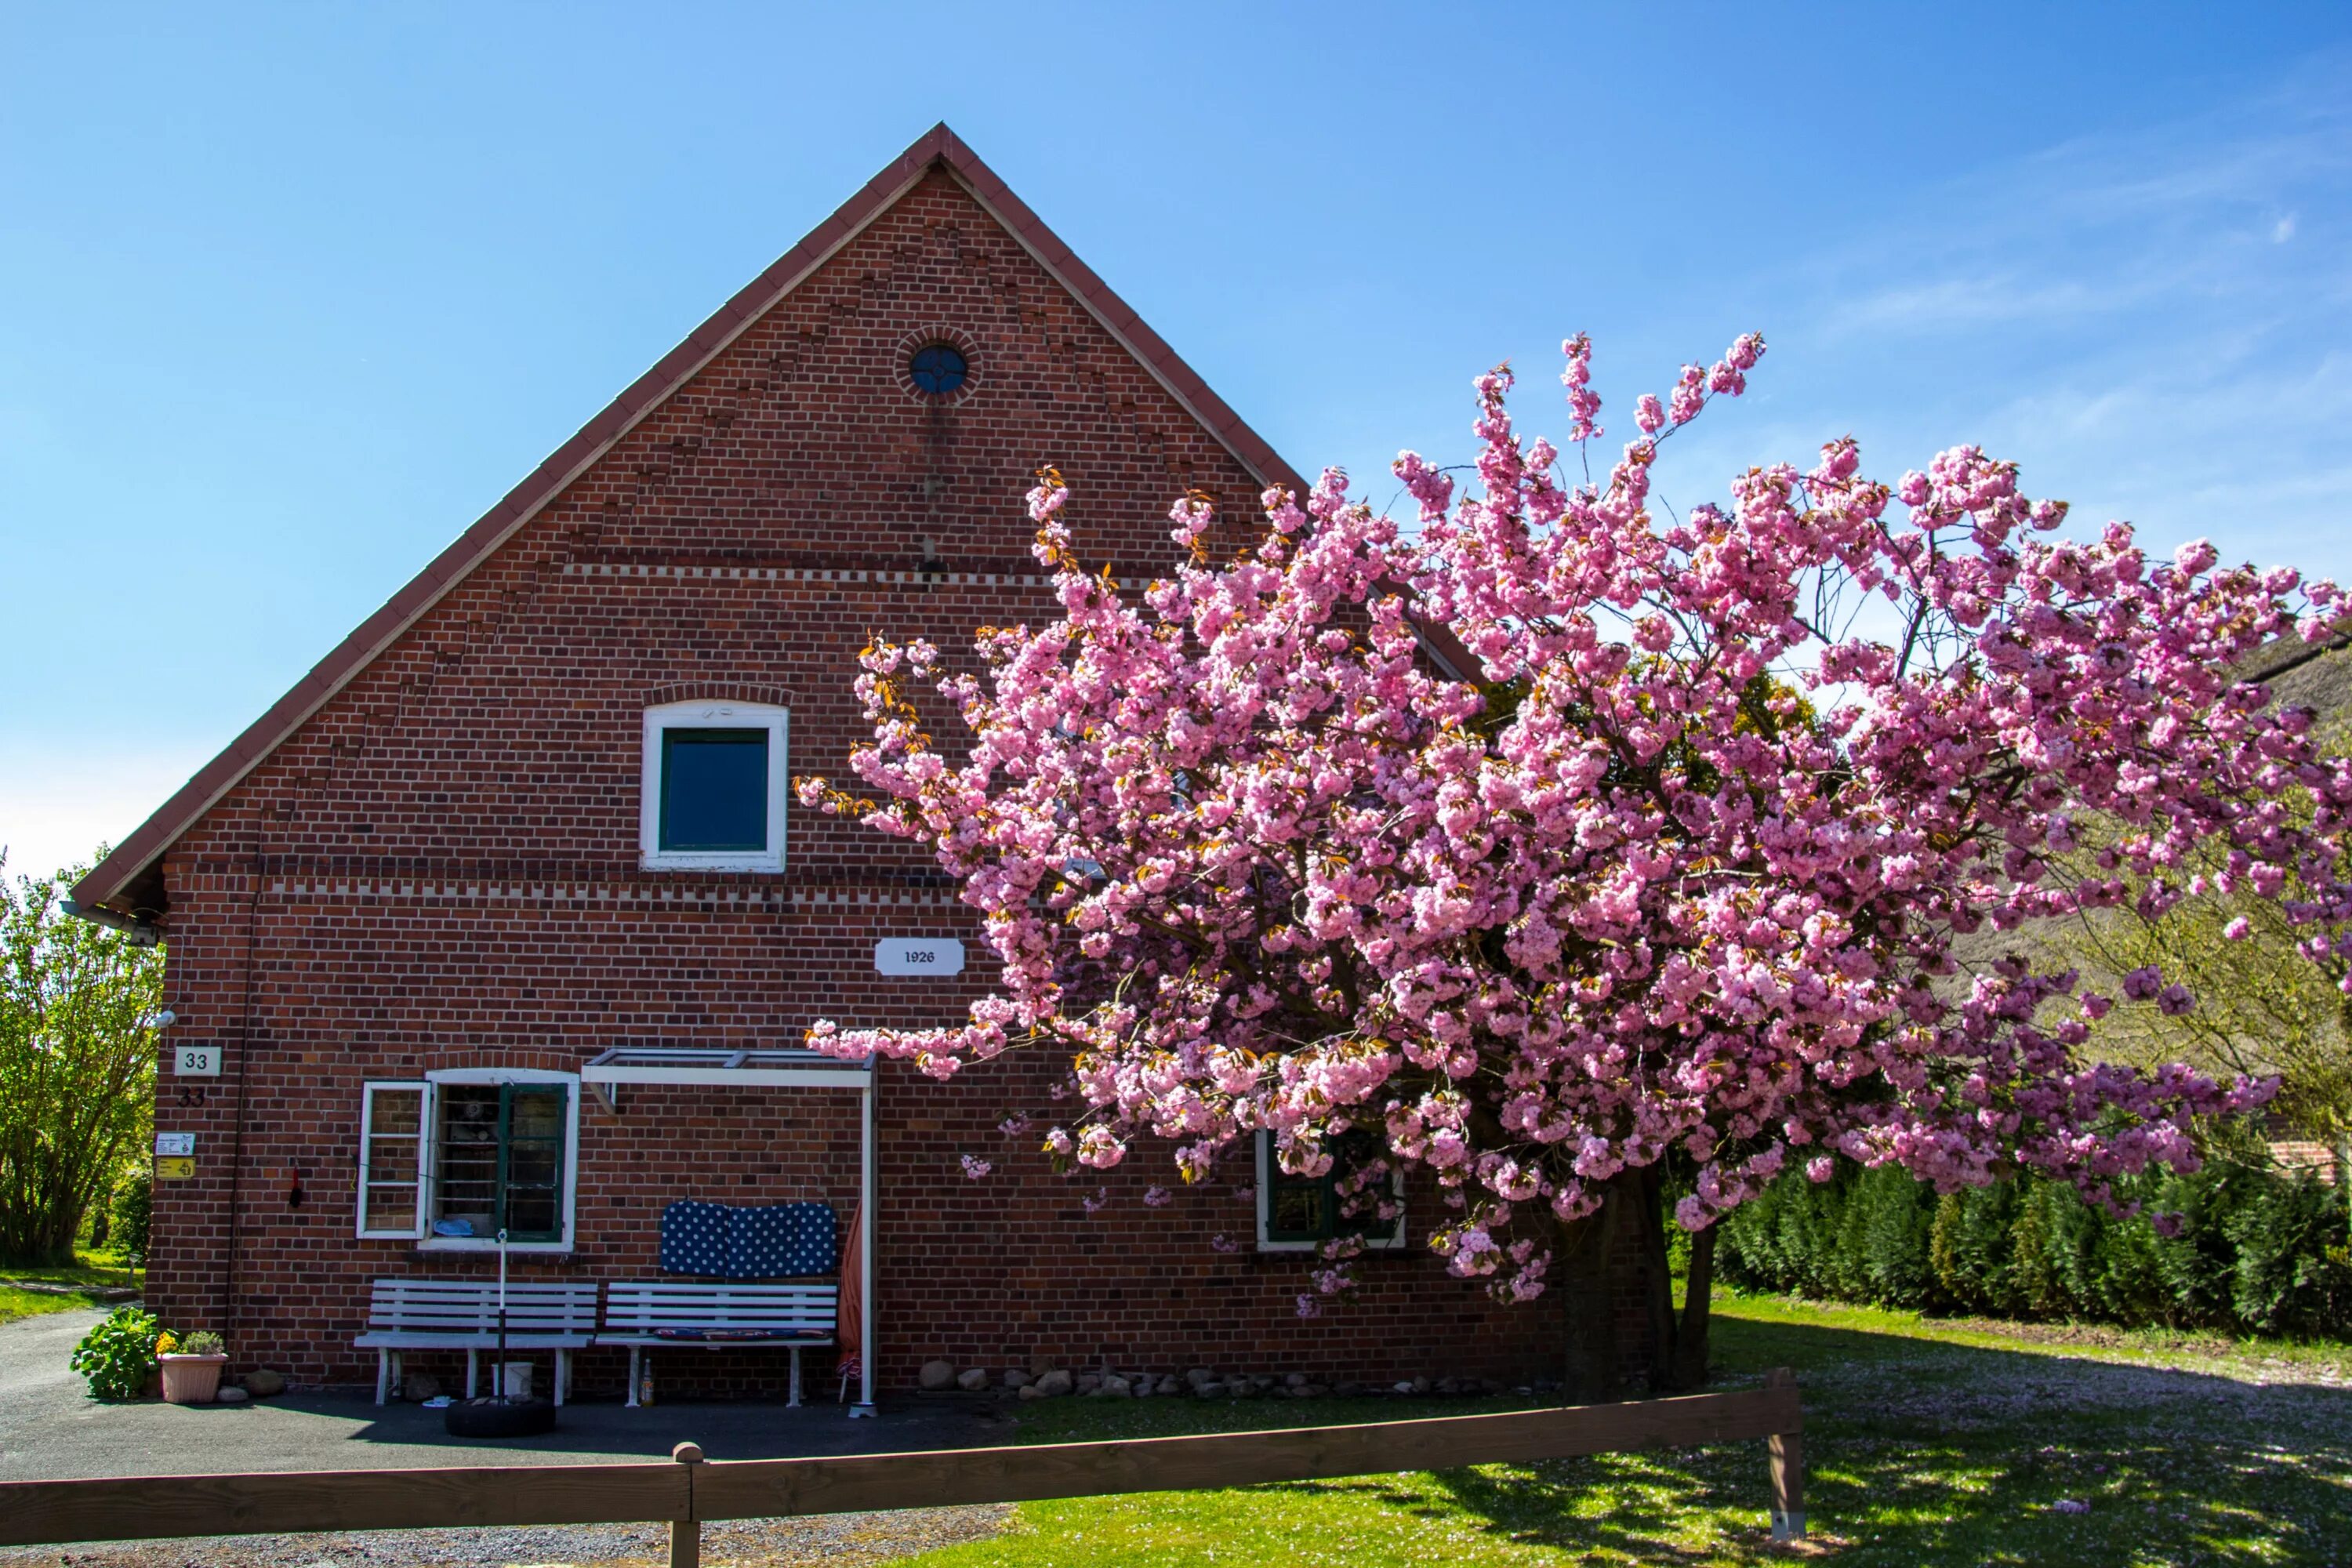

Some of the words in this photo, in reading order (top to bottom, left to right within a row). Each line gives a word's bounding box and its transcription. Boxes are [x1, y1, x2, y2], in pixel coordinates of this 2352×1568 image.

[905, 951, 935, 963] 1926
[185, 1053, 207, 1069] 33
[177, 1087, 205, 1108] 33
